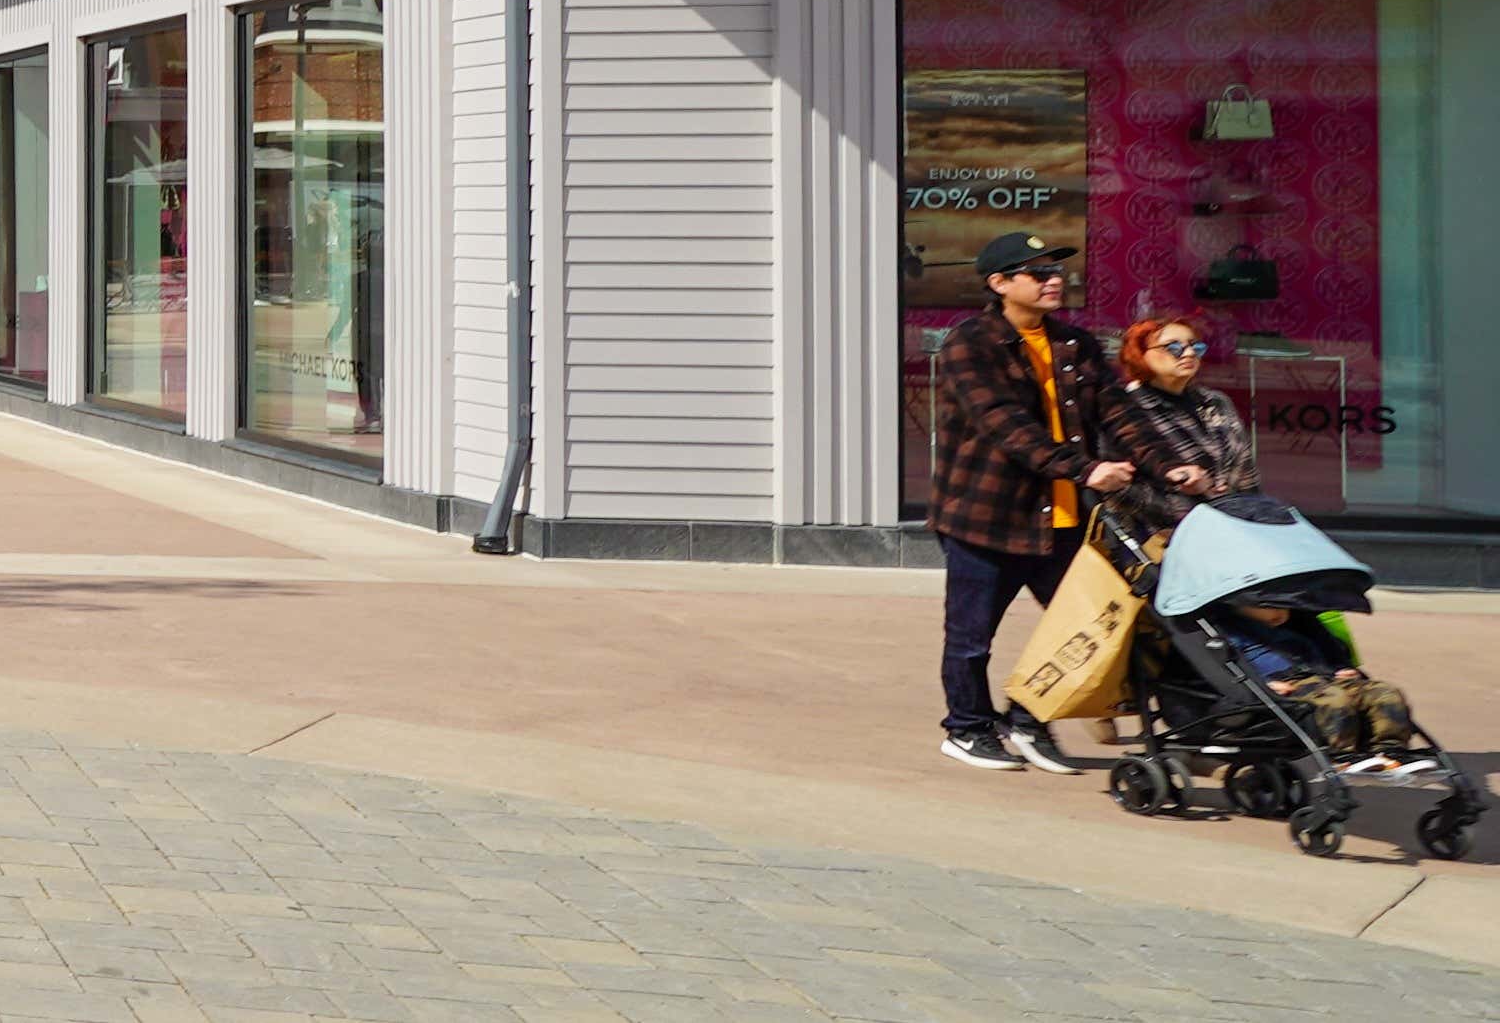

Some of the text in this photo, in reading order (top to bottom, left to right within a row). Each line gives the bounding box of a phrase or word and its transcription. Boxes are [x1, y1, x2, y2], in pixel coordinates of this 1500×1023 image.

[929, 166, 1037, 181] ENJOY UP TO
[905, 186, 979, 210] 70%
[331, 358, 365, 383] KORS
[1267, 404, 1397, 435] KORS
